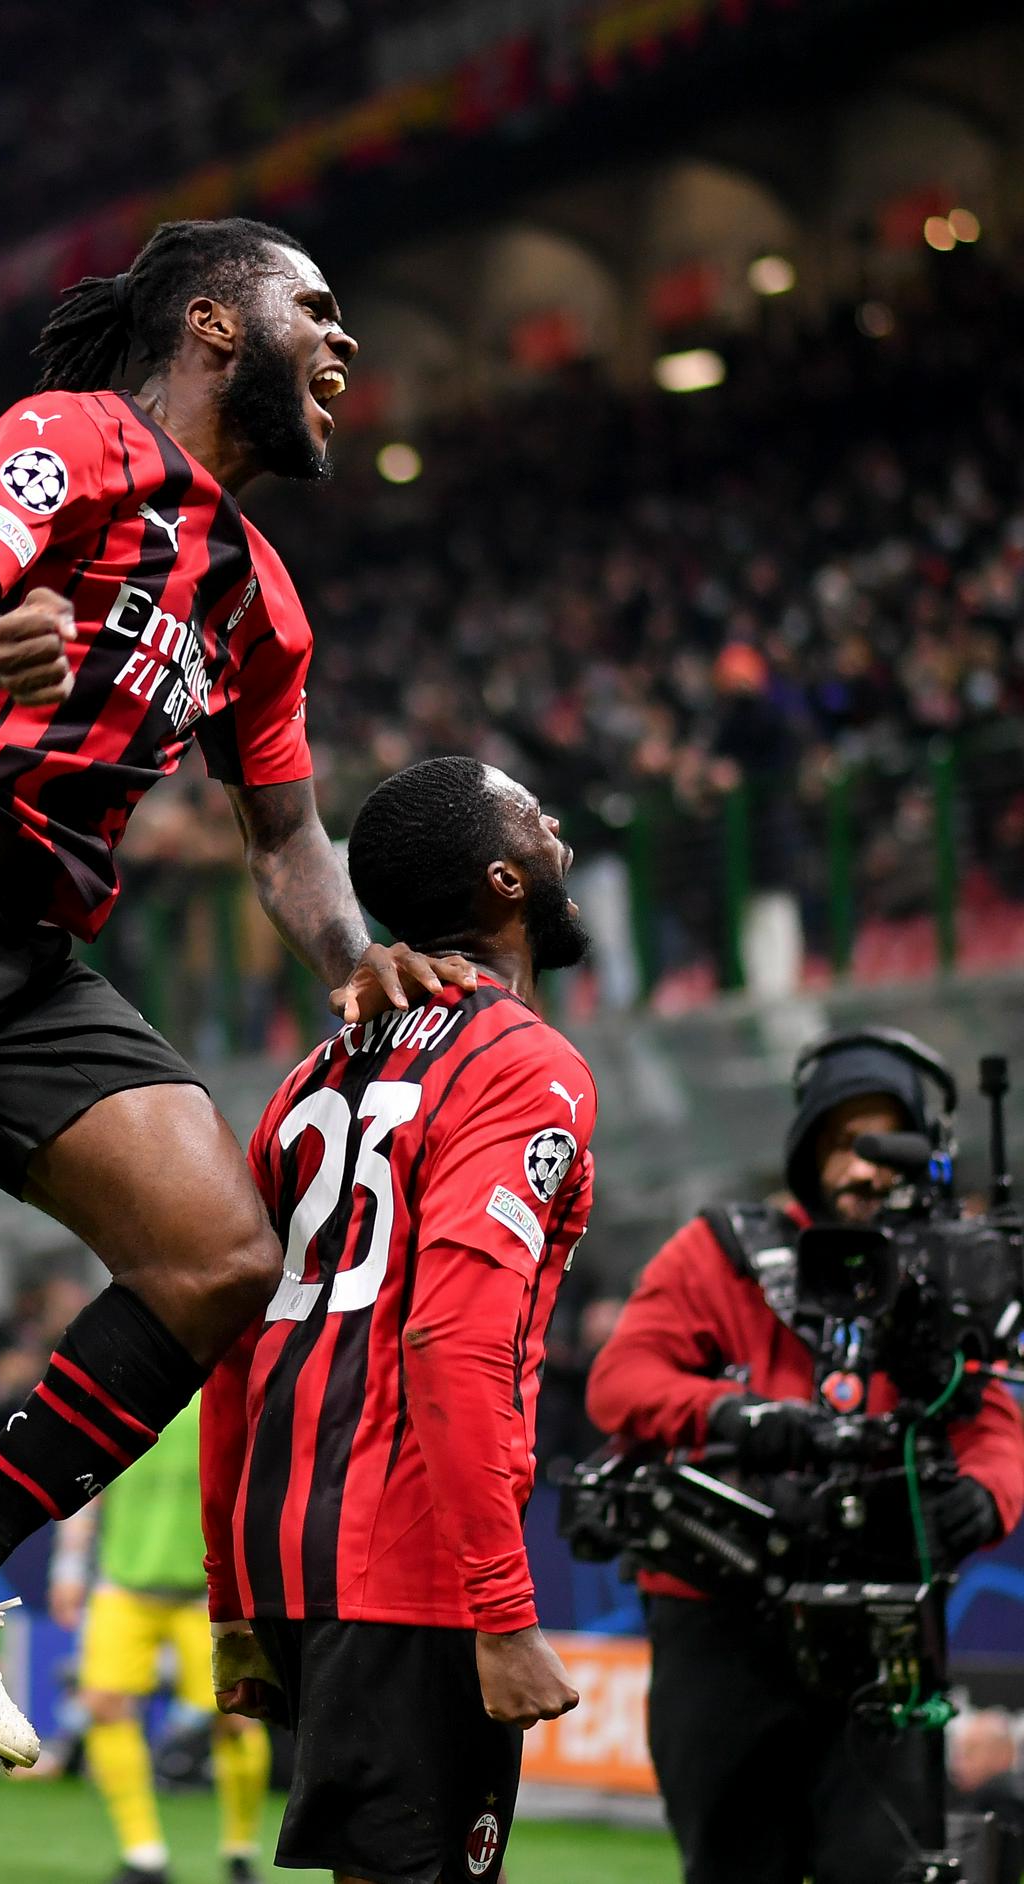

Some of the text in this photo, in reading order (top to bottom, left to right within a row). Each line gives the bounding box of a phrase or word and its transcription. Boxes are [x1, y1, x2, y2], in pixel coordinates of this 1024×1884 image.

[105, 582, 213, 716] Emirates
[113, 650, 171, 702] FLY
[264, 1080, 423, 1322] 23
